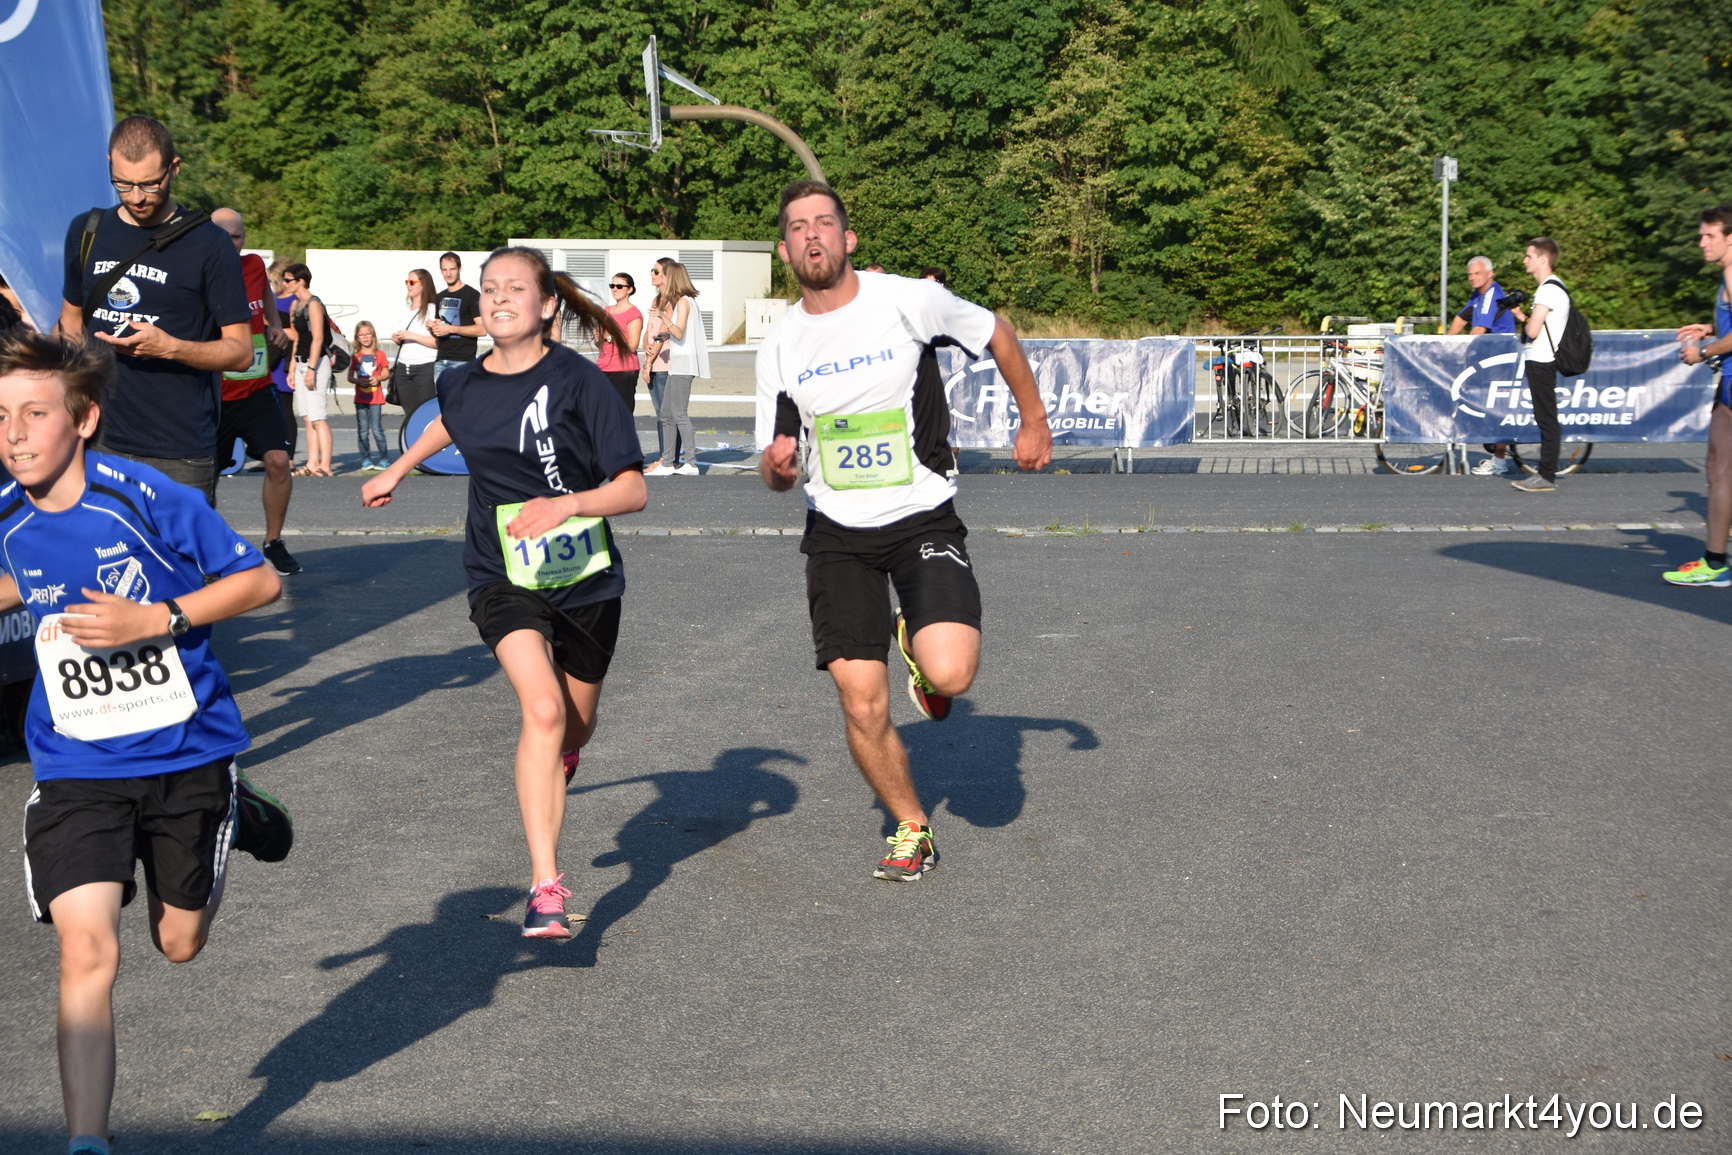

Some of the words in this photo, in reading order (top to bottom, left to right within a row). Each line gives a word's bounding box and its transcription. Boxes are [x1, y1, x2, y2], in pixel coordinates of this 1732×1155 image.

[93, 260, 168, 284] EISAREN
[797, 348, 894, 385] DELPHI
[989, 417, 1116, 431] AUMOBILE
[1499, 412, 1634, 426] AUMOBILE
[836, 441, 893, 469] 285
[94, 540, 129, 559] Yannik
[514, 528, 593, 566] 1131
[105, 566, 121, 588] FSV
[116, 561, 139, 597] RNGAU
[537, 568, 562, 577] Theresa
[58, 645, 171, 700] 8938
[58, 690, 188, 721] www.df-sports.de
